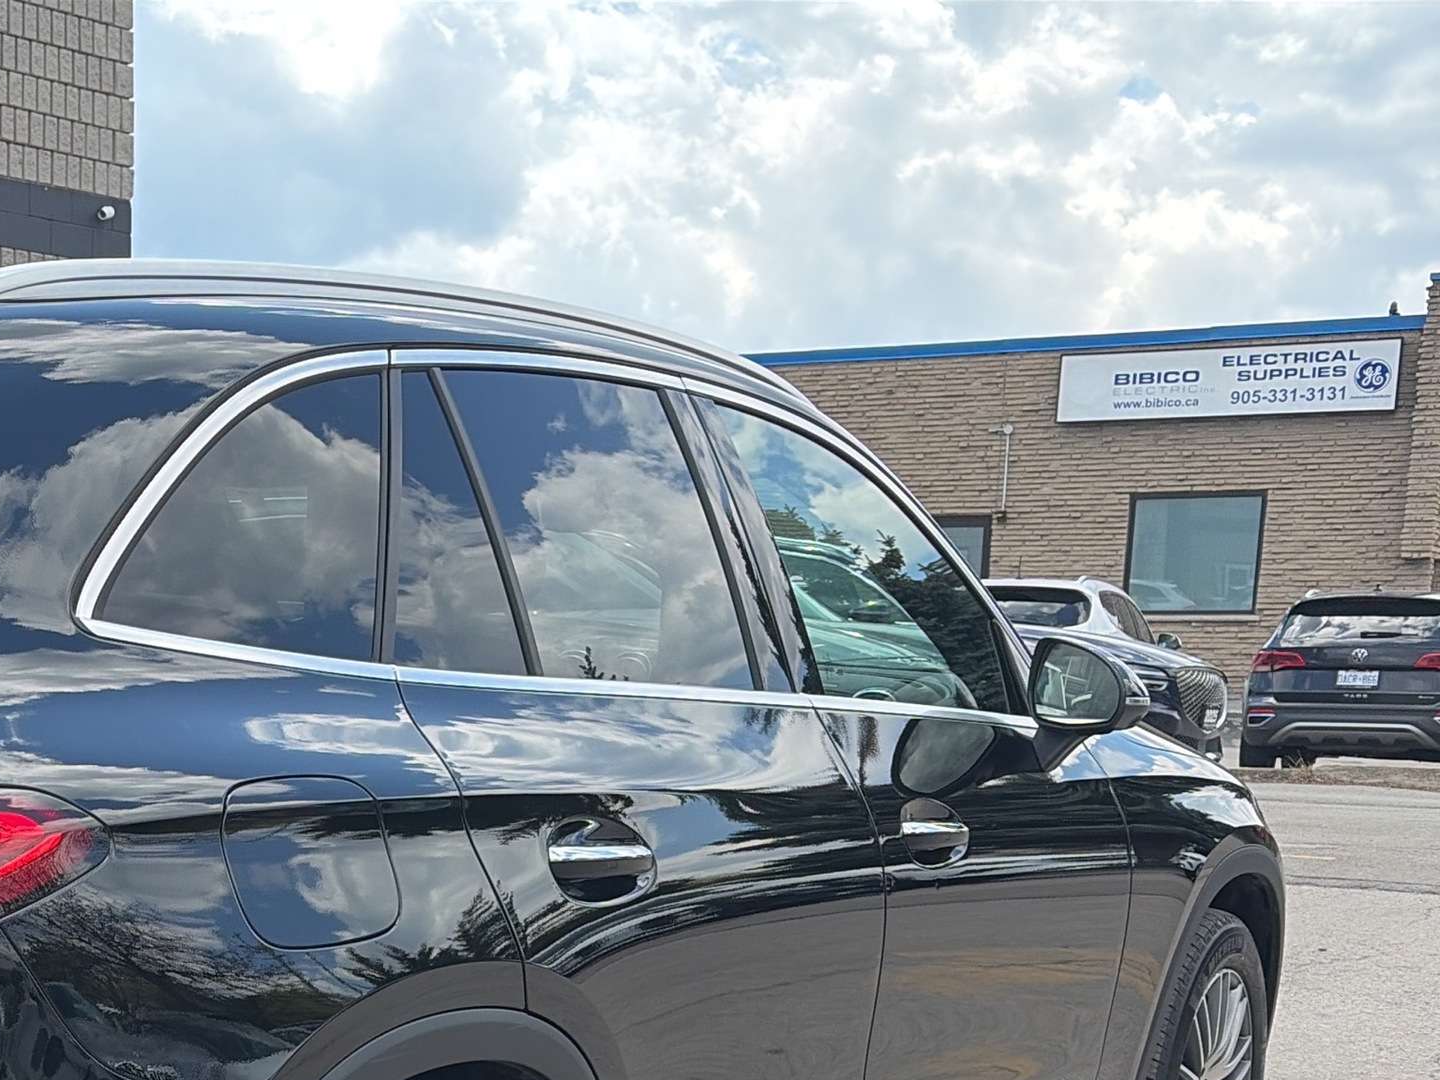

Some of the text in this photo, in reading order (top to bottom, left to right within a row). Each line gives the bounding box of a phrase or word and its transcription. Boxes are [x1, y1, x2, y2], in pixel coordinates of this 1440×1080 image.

[1222, 349, 1361, 367] ELECTRICAL
[1113, 370, 1200, 386] BIBICO
[1237, 365, 1347, 382] SUPPLIES
[1112, 385, 1198, 397] ELECTRIC
[1230, 385, 1347, 405] 905-331-3131
[1113, 397, 1199, 409] www.bibico.ca
